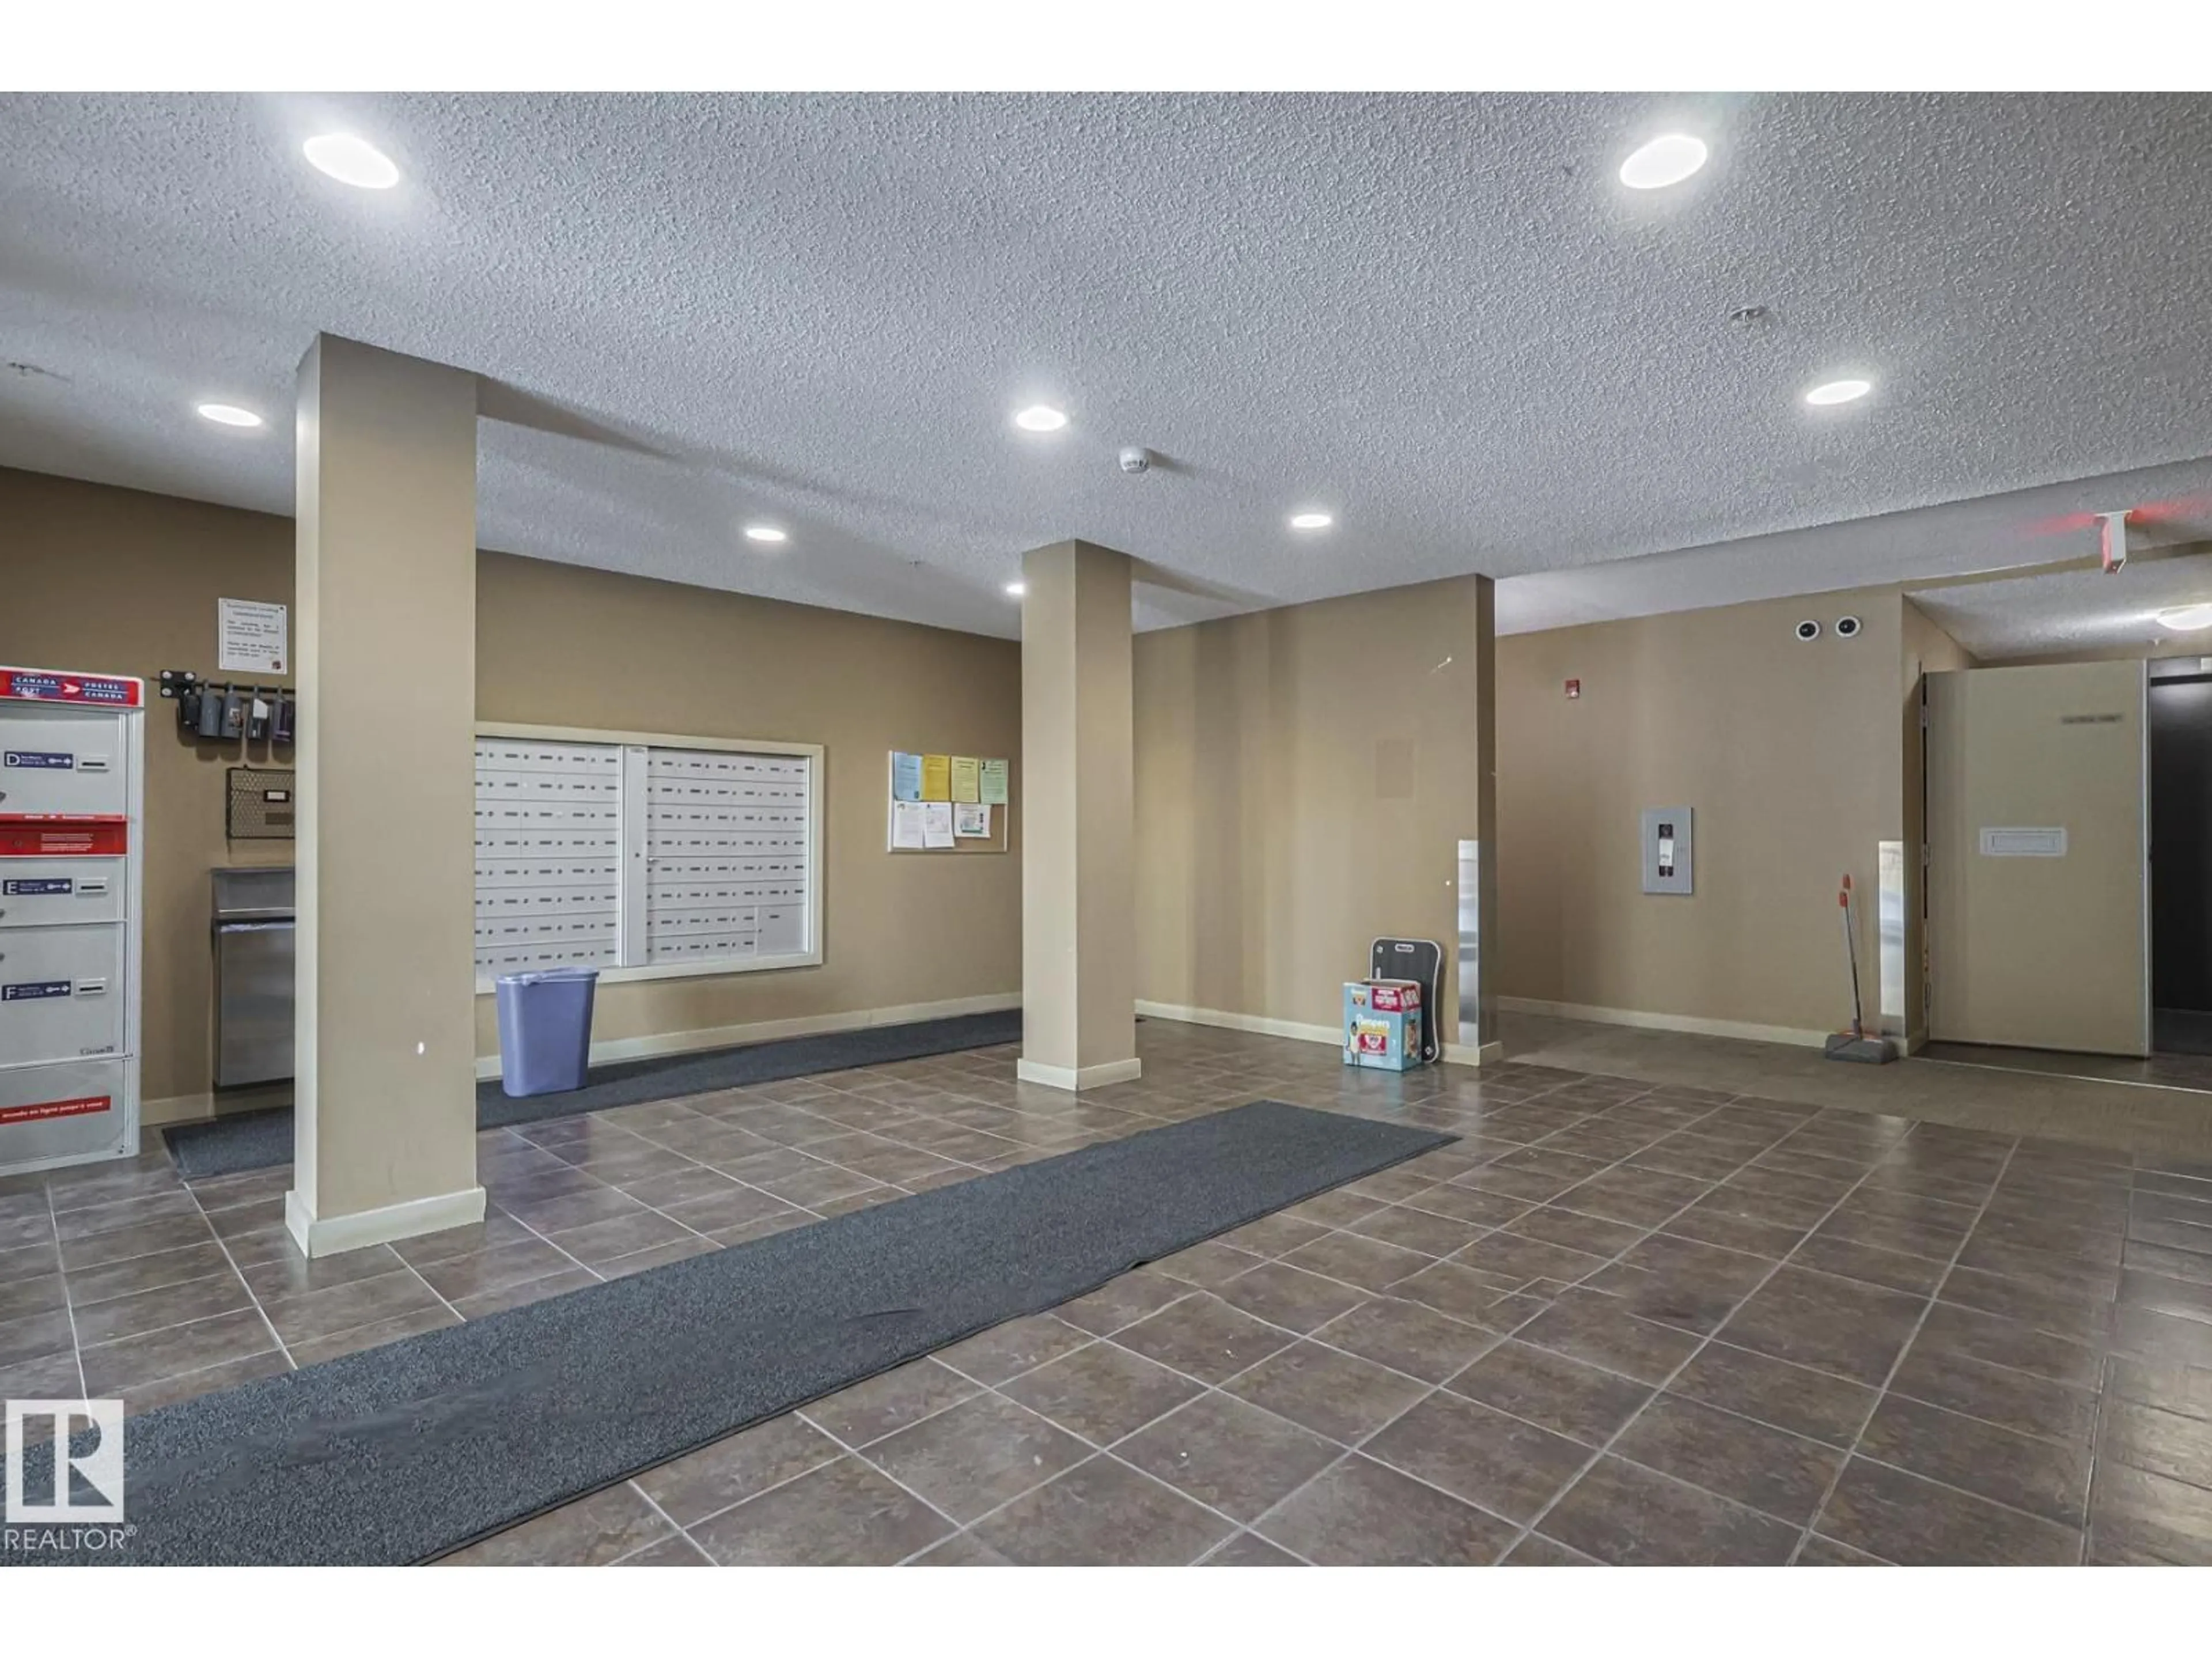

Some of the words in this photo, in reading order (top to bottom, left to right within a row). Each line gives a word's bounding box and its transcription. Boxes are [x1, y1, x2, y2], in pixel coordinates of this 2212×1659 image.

[16, 676, 56, 685] CANADA
[16, 686, 40, 694] POST
[6, 753, 21, 766] D
[7, 881, 18, 894] E
[6, 987, 16, 999] F
